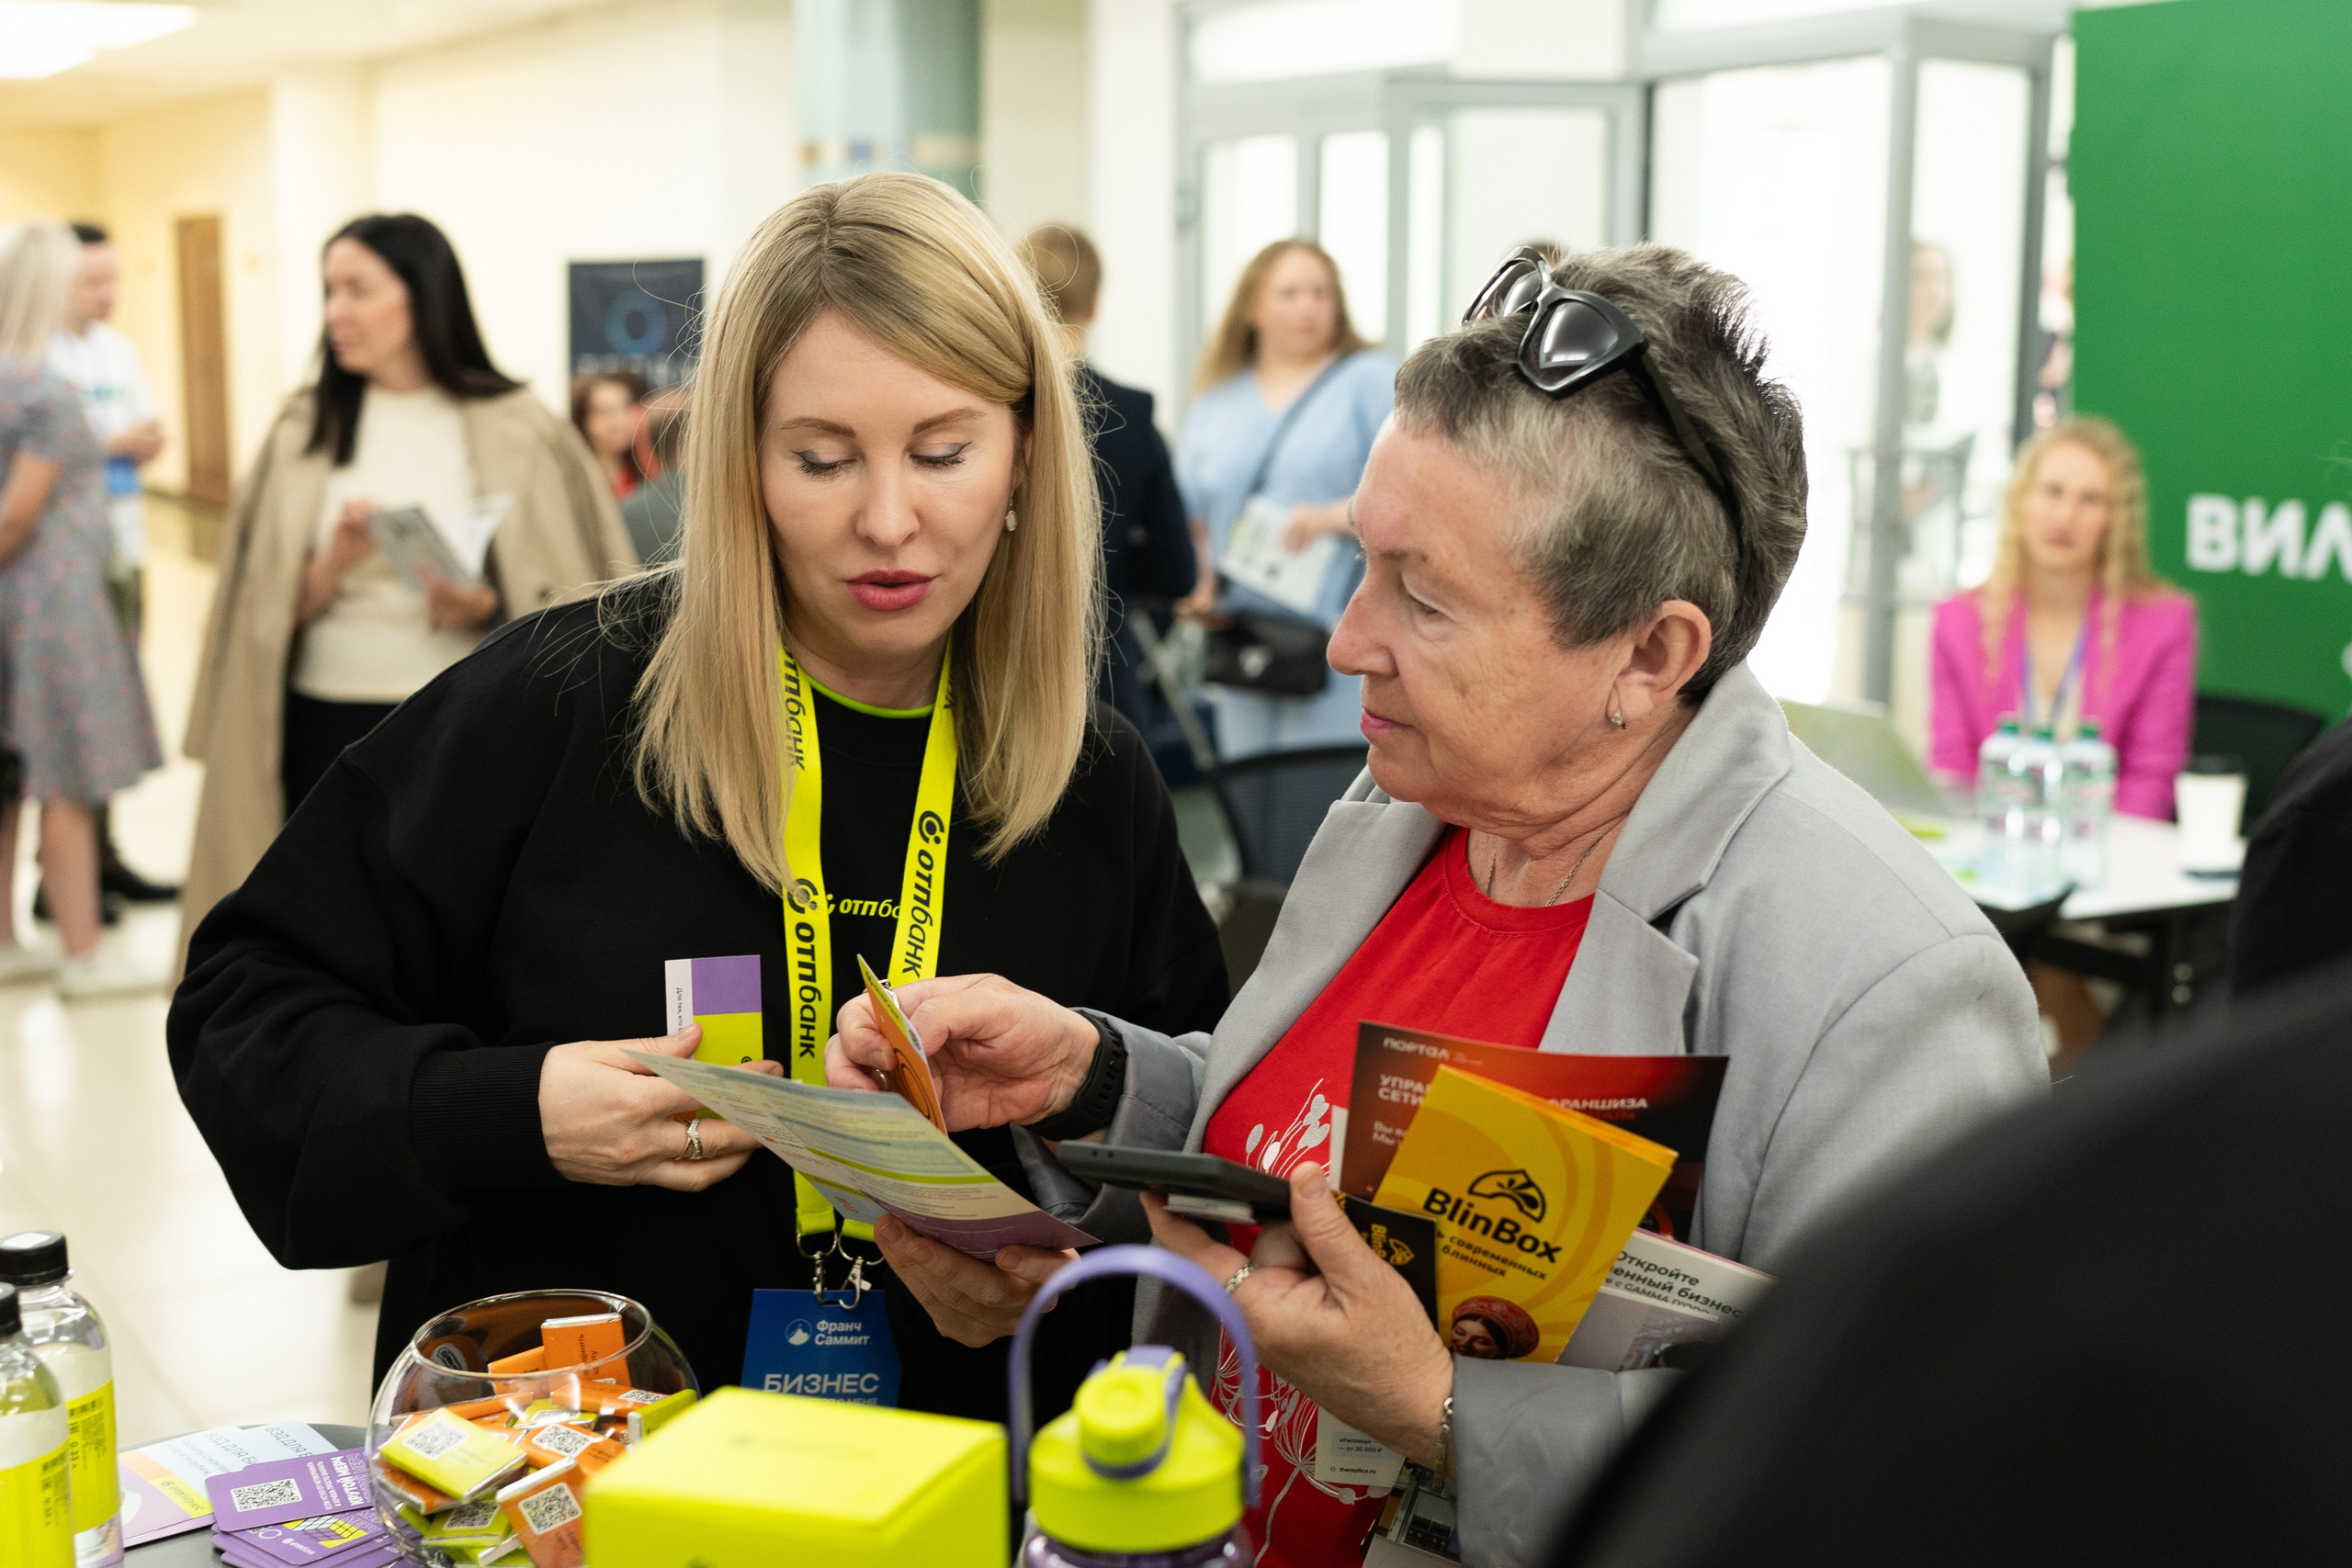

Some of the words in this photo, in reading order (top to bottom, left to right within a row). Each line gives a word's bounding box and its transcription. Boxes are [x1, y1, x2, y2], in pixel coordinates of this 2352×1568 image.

[902, 850, 933, 978] отпбанк
[796, 922, 821, 1058] отпбанк
[1424, 1188, 1562, 1263] BlinBox
[1442, 1245, 1508, 1277] блинных
[1449, 1235, 1547, 1280] современных
[1617, 1250, 1700, 1286] Откройте
[1678, 1287, 1745, 1318] бизнес
[814, 1333, 870, 1346] Саммит
[817, 1320, 862, 1334] Франч
[763, 1372, 879, 1394] БИЗНЕС
